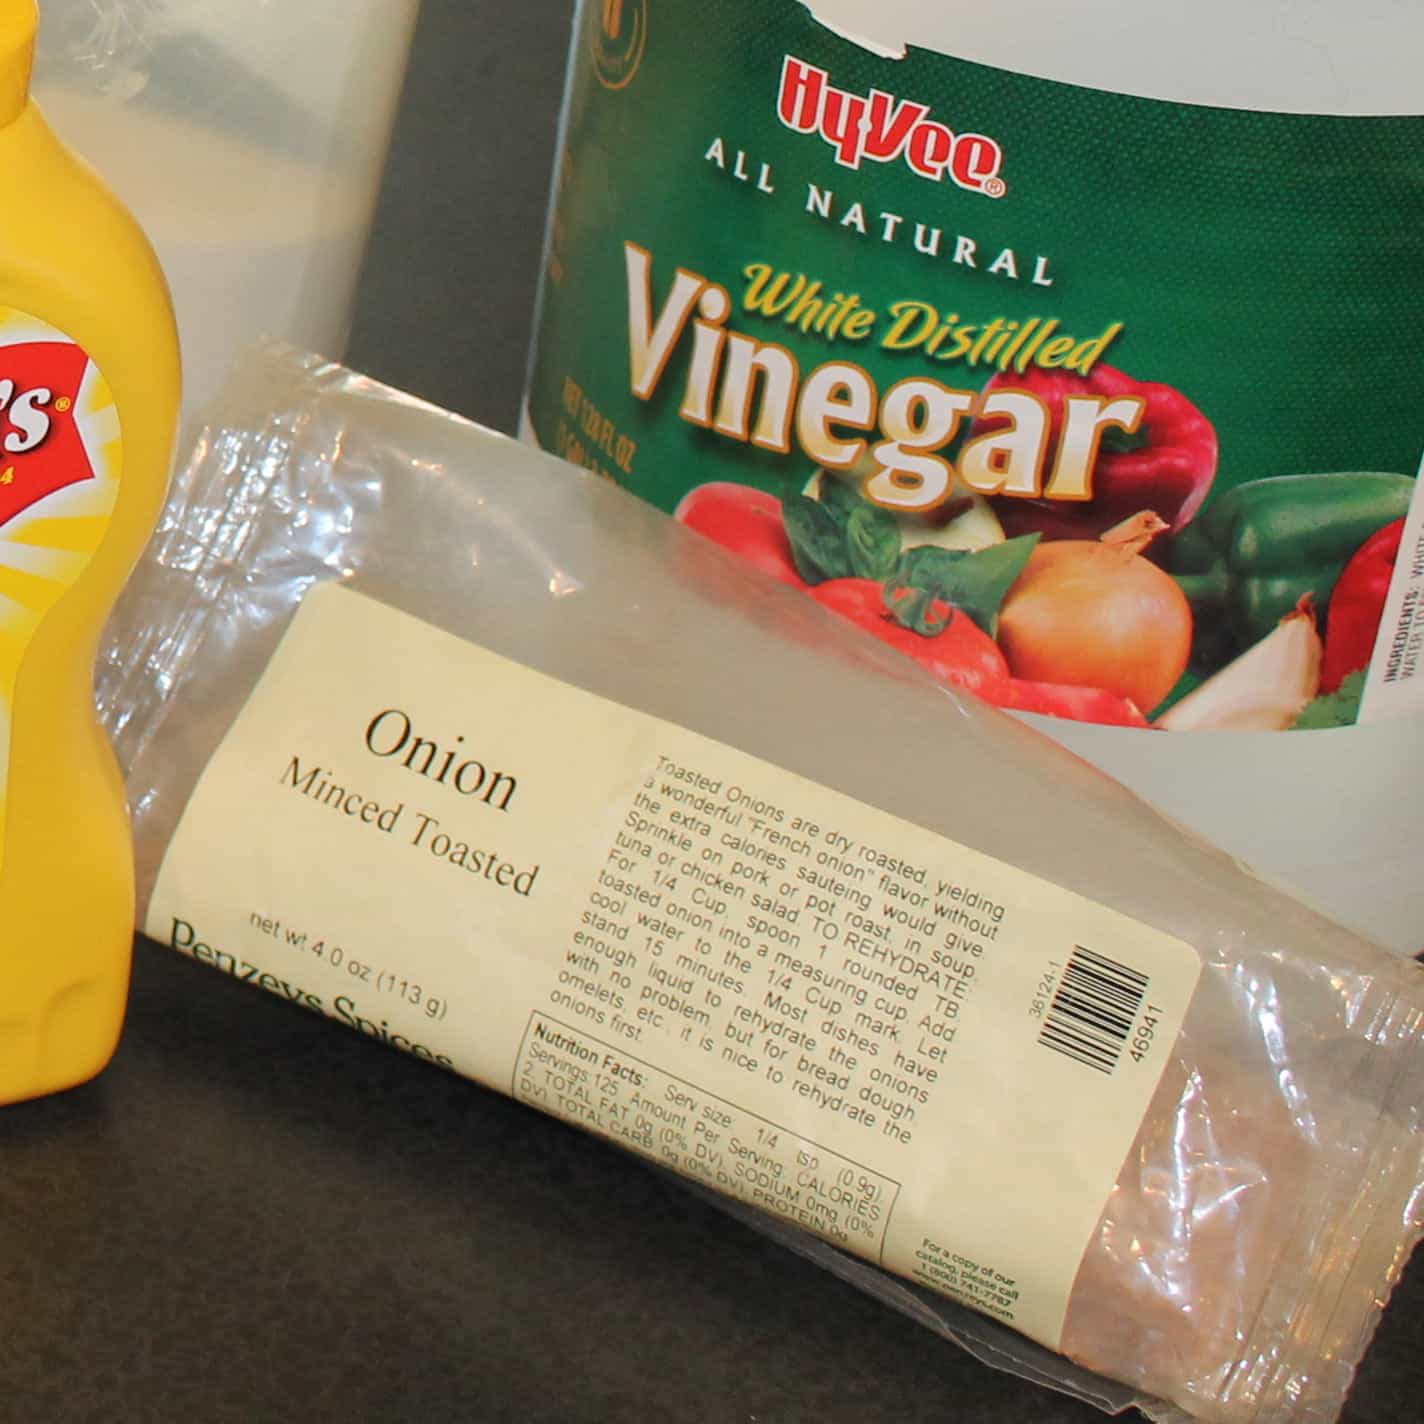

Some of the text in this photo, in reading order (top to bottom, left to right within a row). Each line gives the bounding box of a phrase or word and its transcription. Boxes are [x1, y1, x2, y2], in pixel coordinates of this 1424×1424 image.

[777, 55, 1002, 192] HyVee
[705, 138, 1053, 287] ALL NATURAL
[624, 240, 1146, 512] Vinegar
[742, 261, 1123, 375] White Distilled
[280, 756, 540, 898] Minced Toasted
[364, 709, 517, 811] Onion
[632, 792, 663, 815] the
[667, 808, 713, 838] extra
[718, 830, 788, 871] calories
[793, 864, 873, 911] sauteing
[879, 901, 937, 937] would
[653, 755, 722, 795] Toasted
[724, 785, 786, 823] Onions
[789, 816, 820, 839] are
[822, 828, 855, 857] dry
[932, 877, 1007, 923] yielding
[658, 780, 743, 827] wonderful
[875, 874, 930, 910] flavor
[930, 899, 1000, 941] without
[171, 917, 323, 1013] Penzeys
[248, 908, 450, 1022] net wt 4.0 oz (113 g)
[569, 929, 931, 1104] enough liquid to rehydrate the onions
[1128, 1004, 1165, 1064] 46941
[530, 1020, 602, 1065] Nutrition
